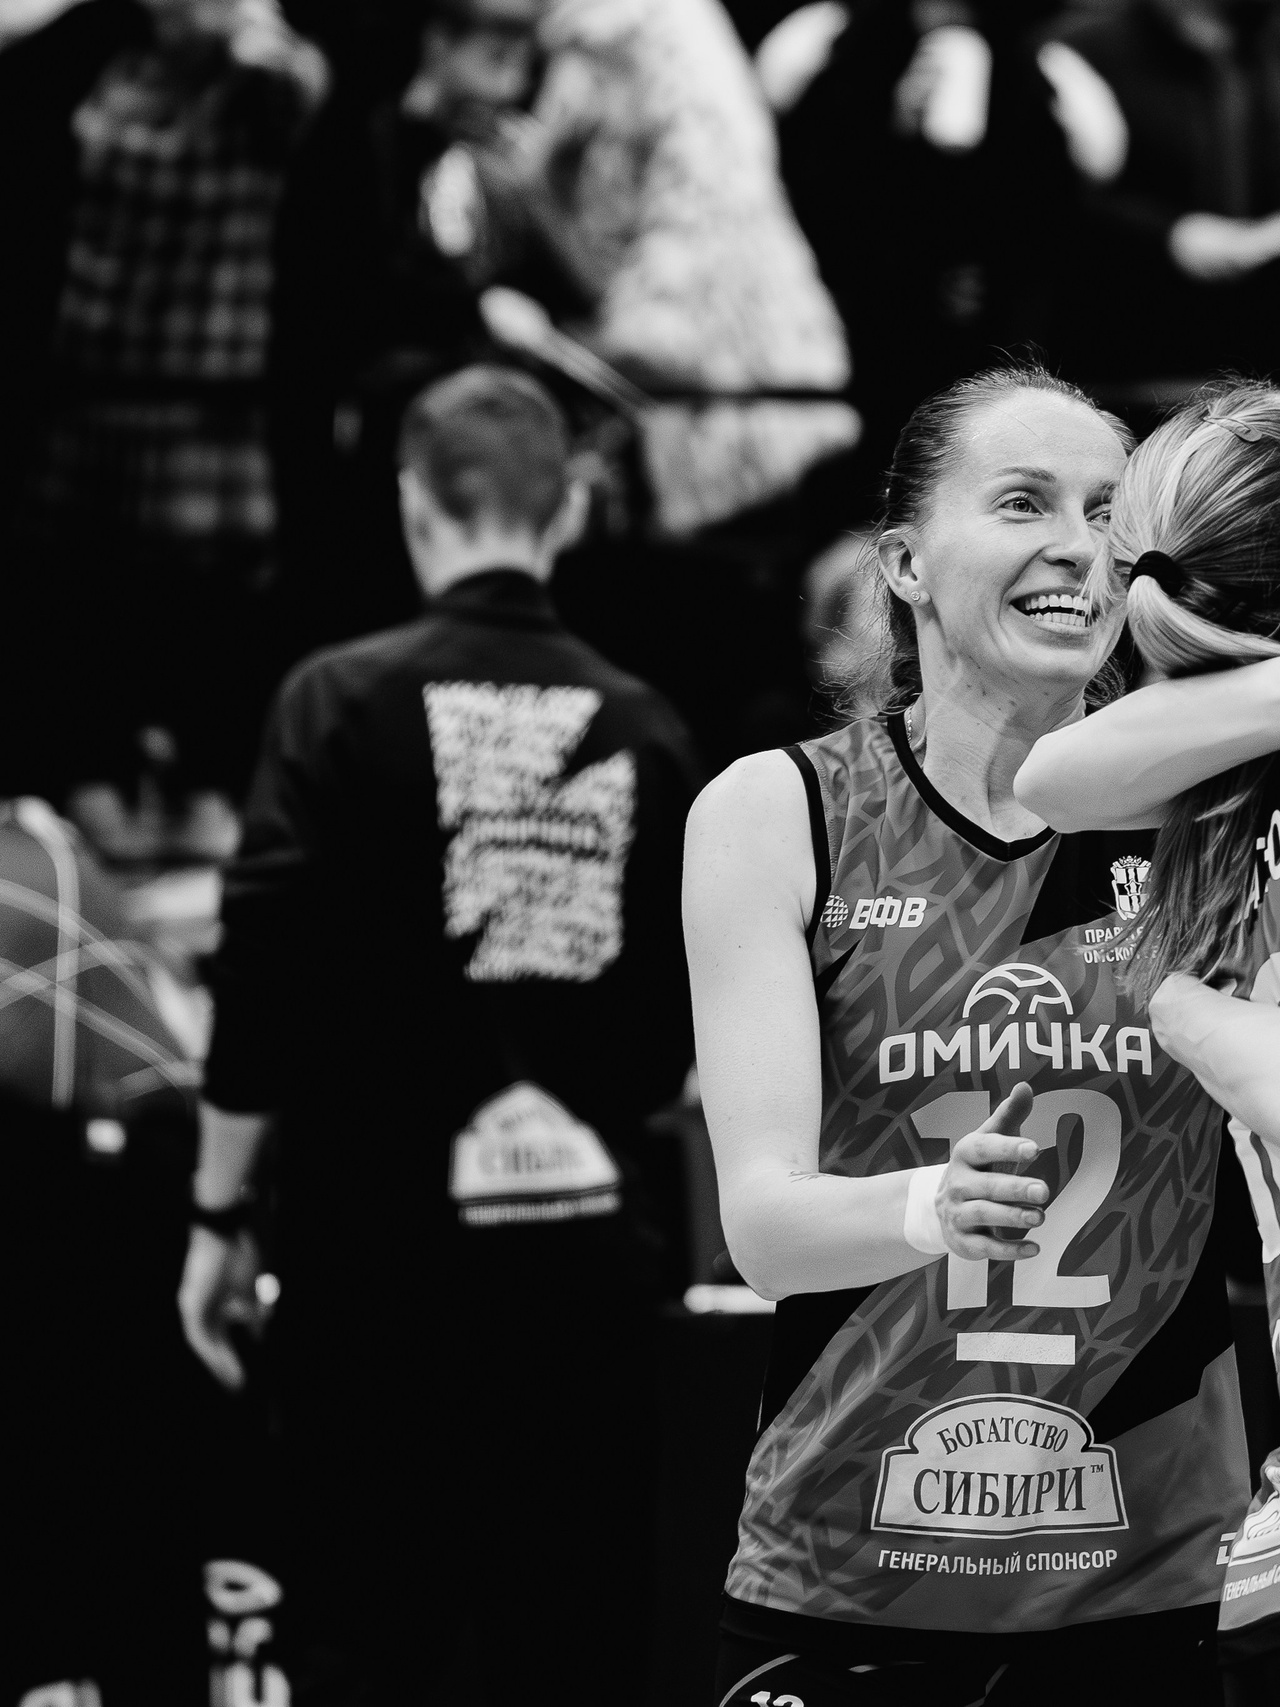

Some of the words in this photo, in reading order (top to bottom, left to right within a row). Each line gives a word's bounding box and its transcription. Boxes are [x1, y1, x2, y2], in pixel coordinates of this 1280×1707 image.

[878, 1021, 1153, 1085] ОМИЧКА
[910, 1088, 1123, 1311] 12
[936, 1416, 1069, 1455] БОГАТСТВО
[913, 1466, 1087, 1518] СИБИРИ
[877, 1549, 1021, 1576] ГЕНЕРАЛЬНЫЙ
[1025, 1549, 1118, 1571] СПОНСОР
